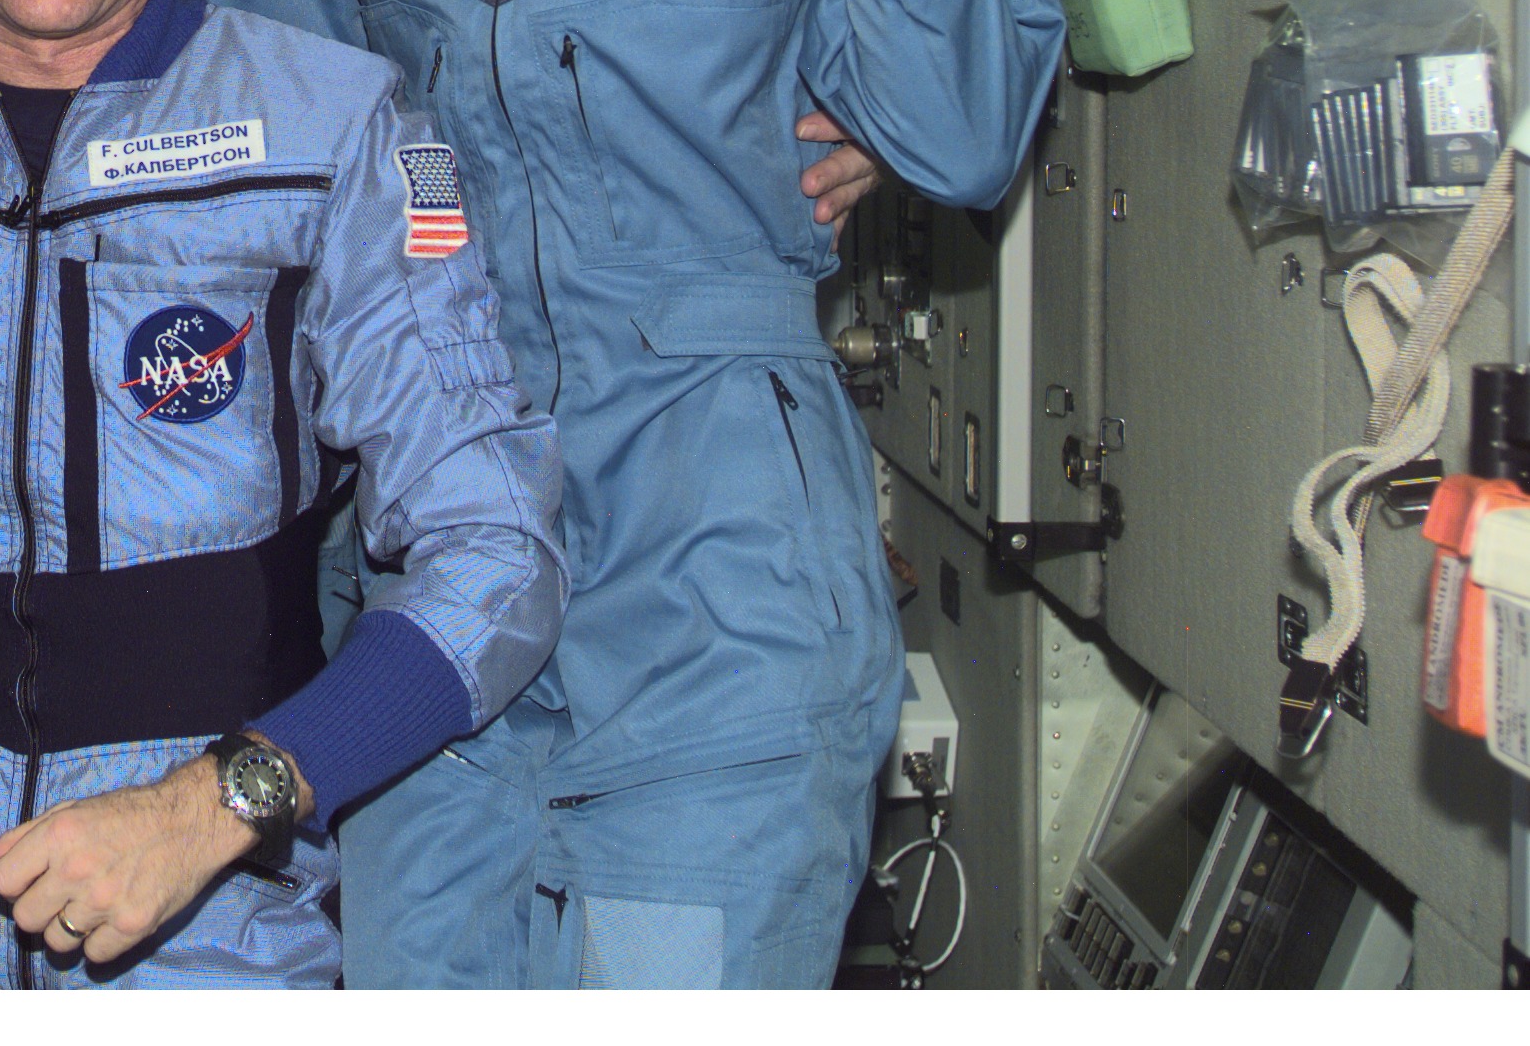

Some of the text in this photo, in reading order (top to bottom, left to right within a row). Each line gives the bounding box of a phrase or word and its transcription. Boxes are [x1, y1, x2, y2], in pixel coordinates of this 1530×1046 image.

[101, 124, 249, 158] F. CULBERTSON
[104, 146, 251, 181] Ф.КАЛБЕРТСОН
[139, 355, 233, 387] NASA
